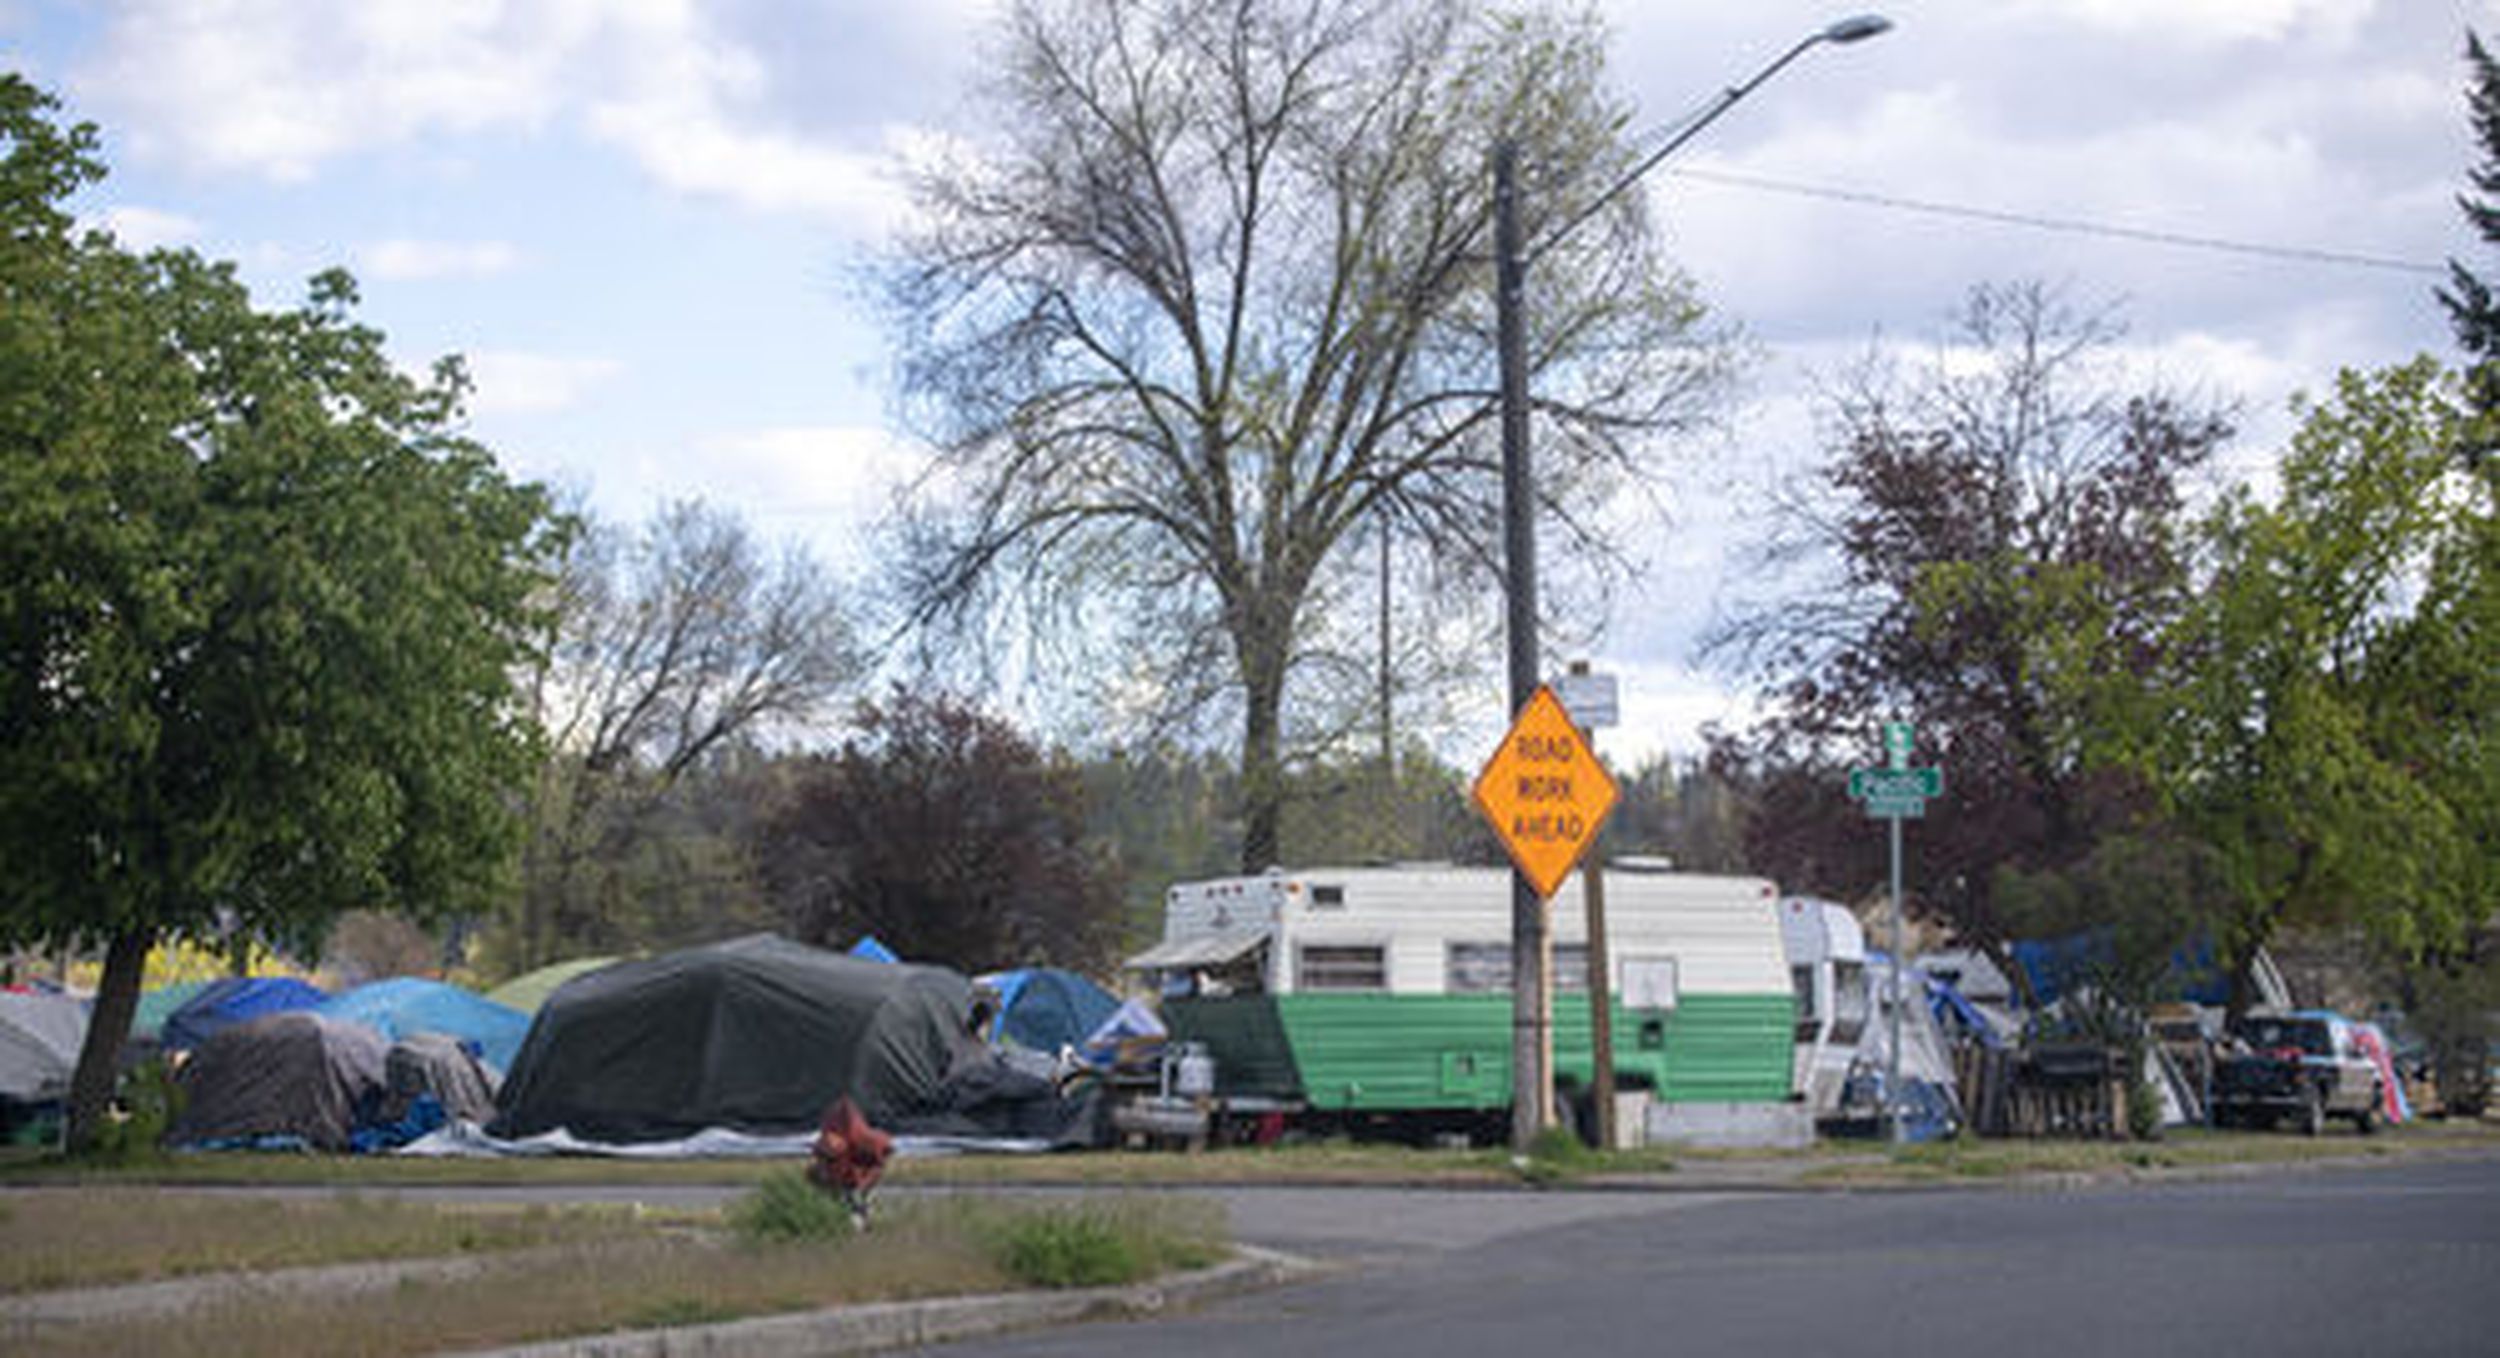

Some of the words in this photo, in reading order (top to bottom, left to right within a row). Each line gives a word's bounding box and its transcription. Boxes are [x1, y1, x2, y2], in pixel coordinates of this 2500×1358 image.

[1517, 736, 1573, 762] ROAD
[1517, 776, 1571, 802] WORK
[1513, 811, 1584, 841] AHEAD
